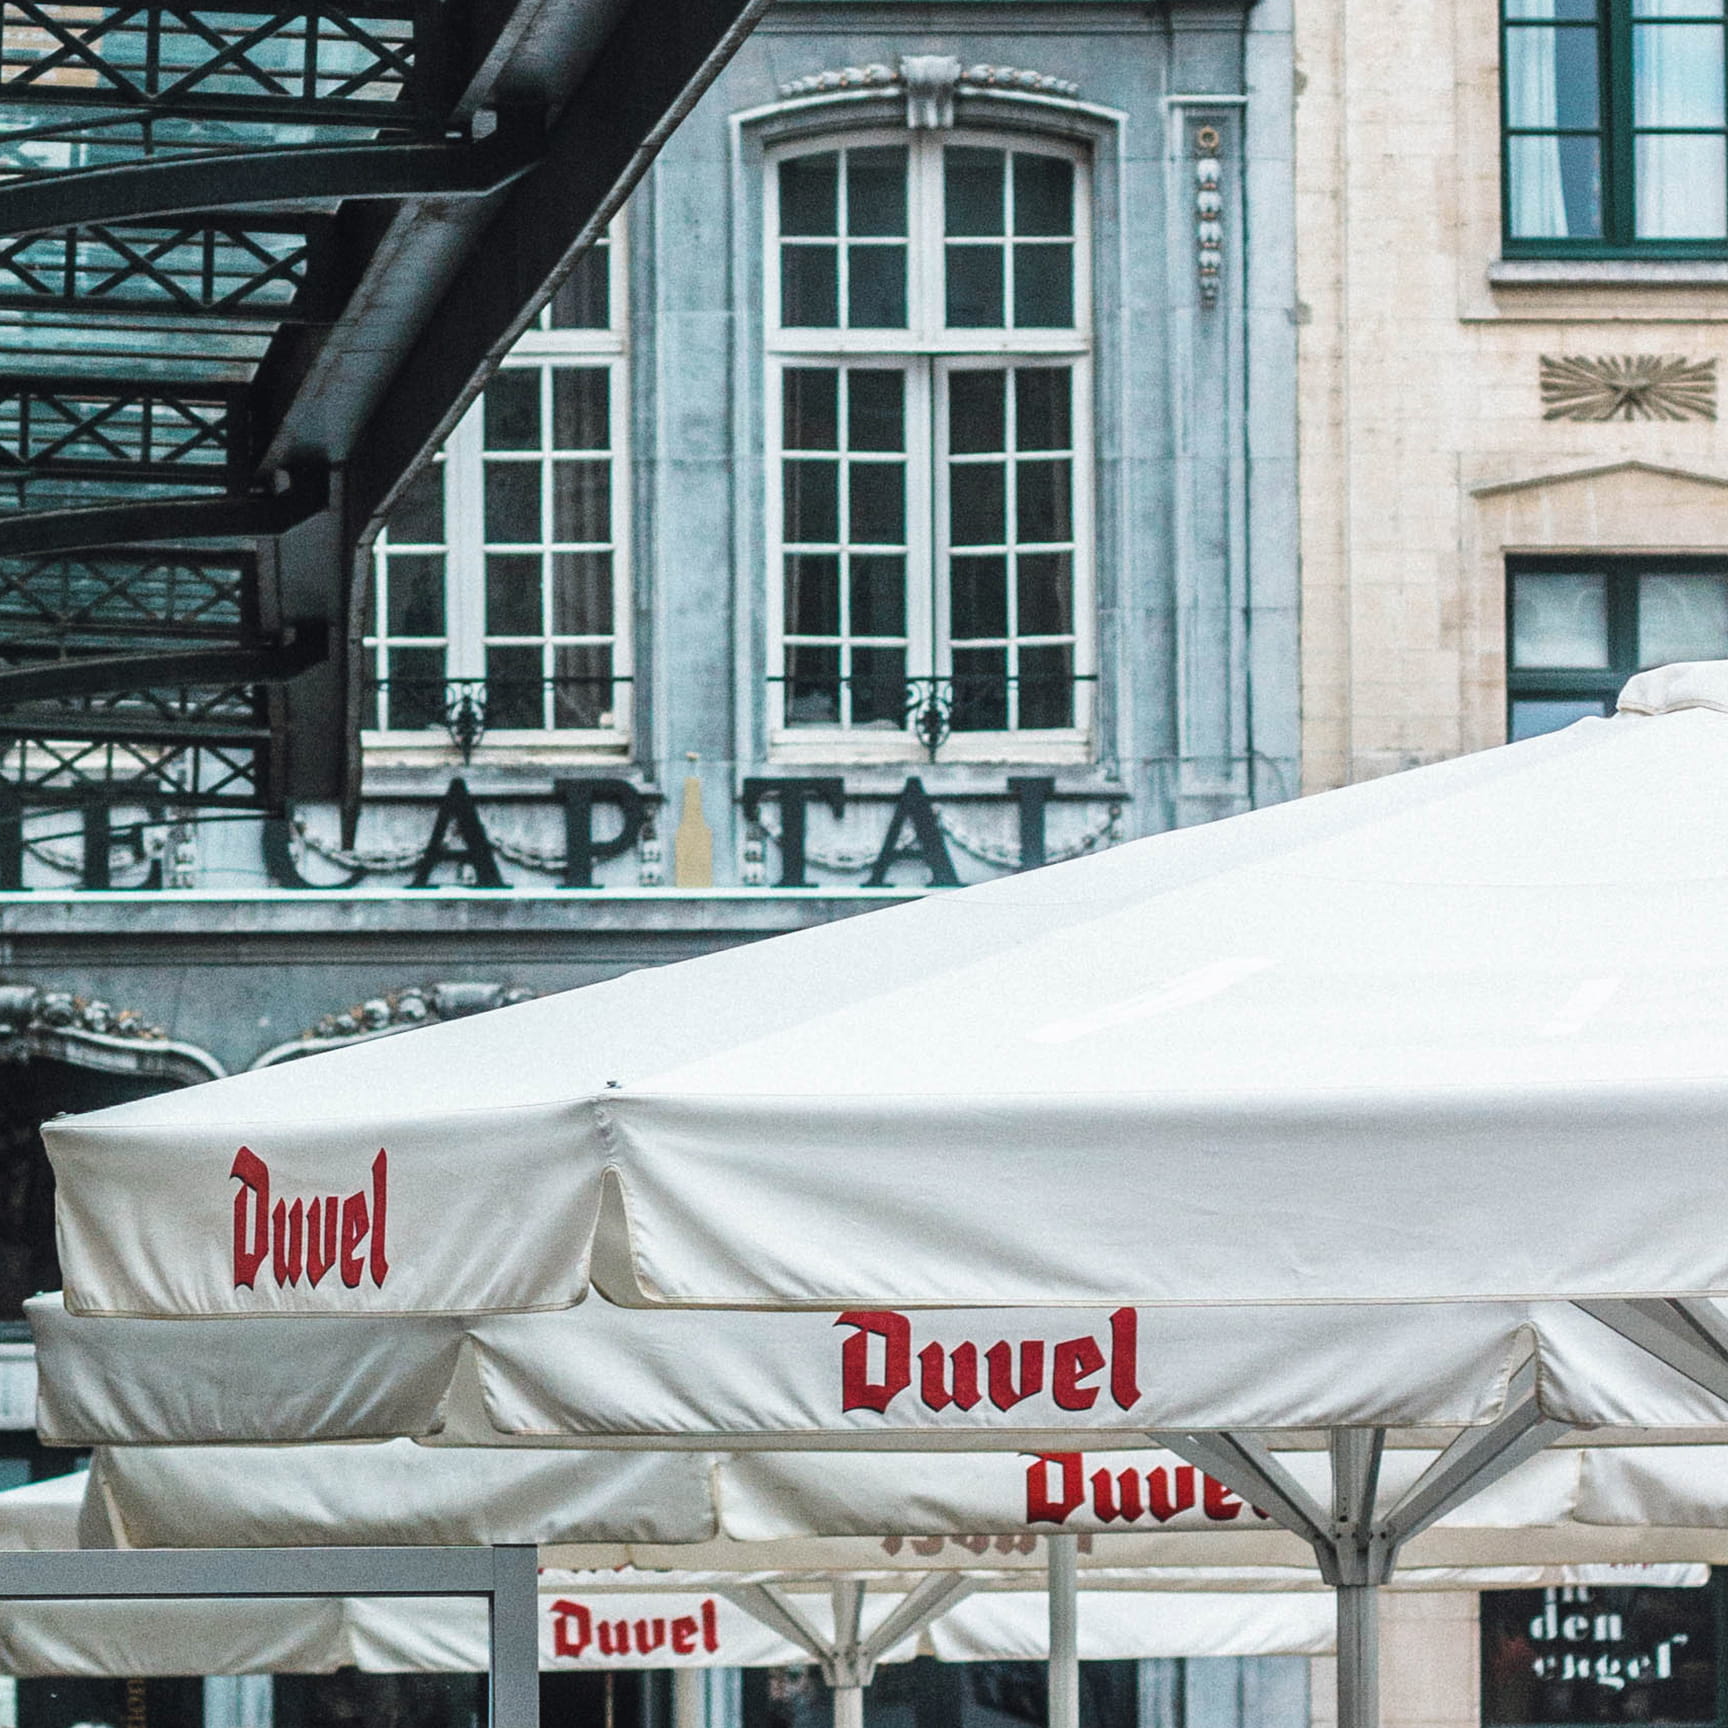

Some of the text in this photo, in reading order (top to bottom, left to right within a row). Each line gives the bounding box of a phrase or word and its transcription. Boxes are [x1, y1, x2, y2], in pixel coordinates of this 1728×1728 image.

[228, 1145, 390, 1291] Duvel
[833, 1307, 1143, 1414] Duvel
[1017, 1451, 1271, 1525] Duve
[549, 1598, 719, 1658] Duvel
[1529, 1601, 1623, 1641] den
[1532, 1633, 1690, 1691] engel
